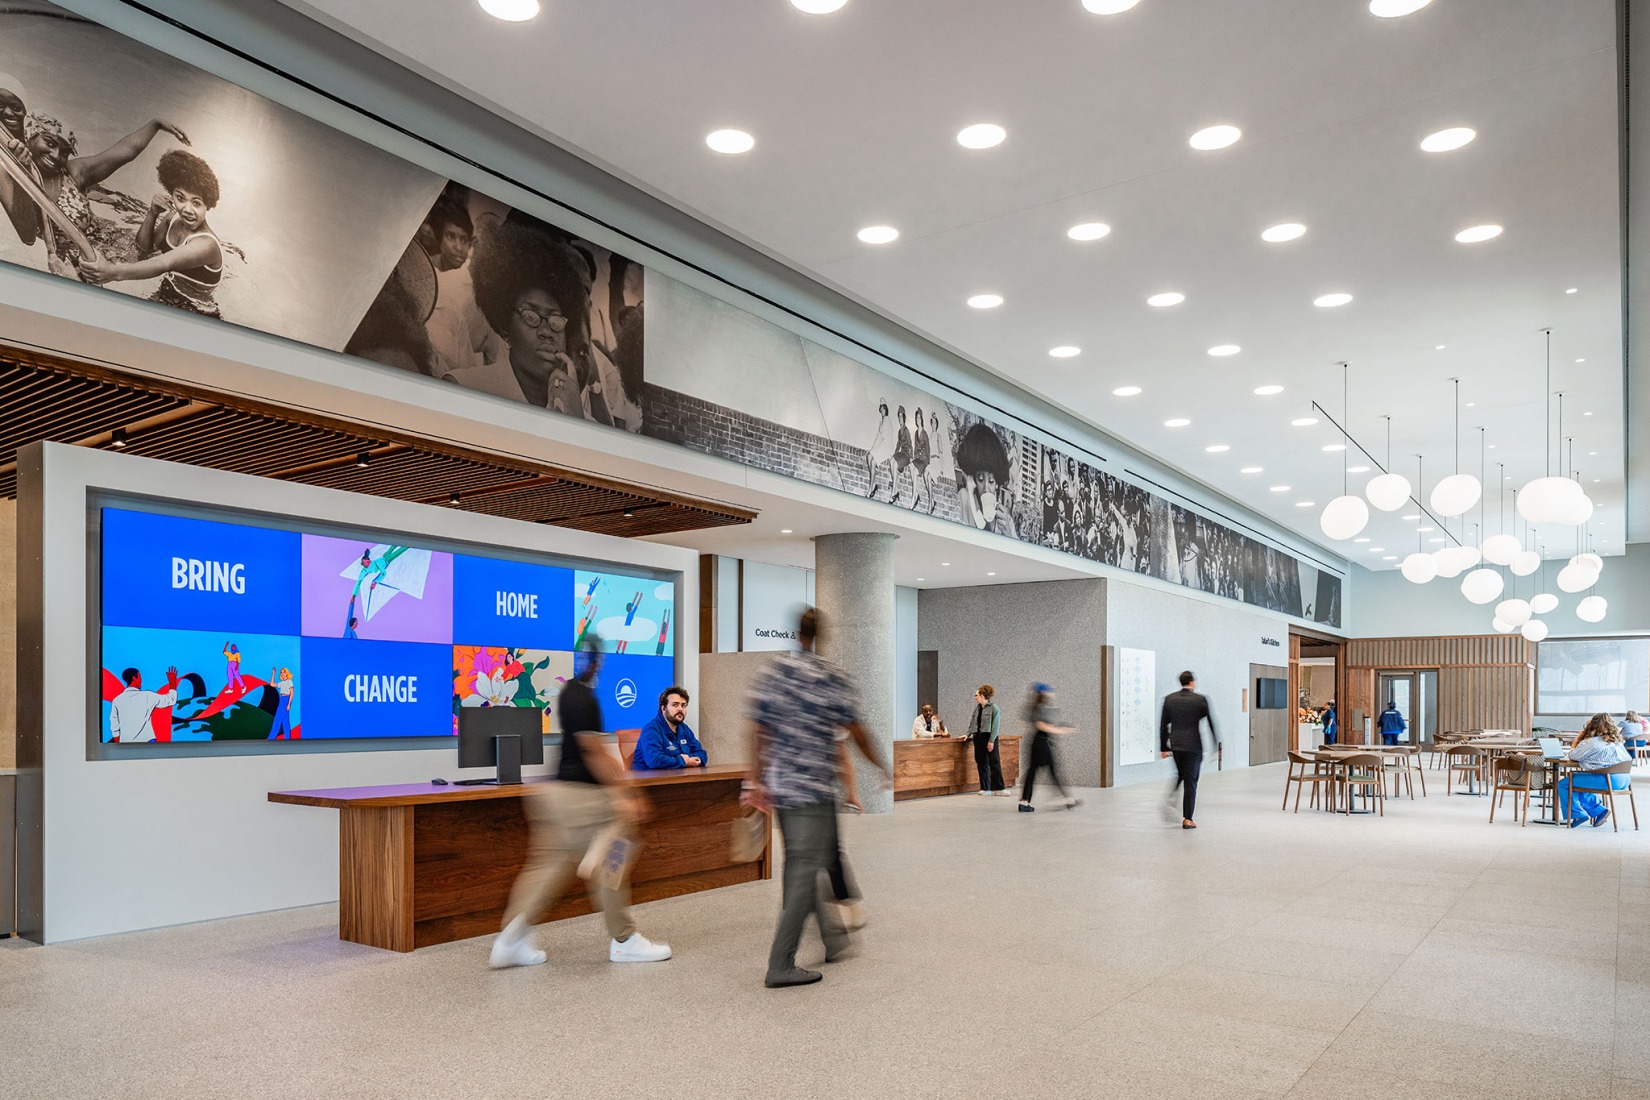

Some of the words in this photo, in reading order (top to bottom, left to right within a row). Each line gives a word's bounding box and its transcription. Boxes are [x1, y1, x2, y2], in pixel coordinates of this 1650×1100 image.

[171, 557, 246, 595] BRING
[495, 590, 539, 619] HOME
[755, 628, 770, 638] Coat
[771, 629, 789, 639] Check
[790, 631, 796, 640] &
[344, 674, 418, 703] CHANGE
